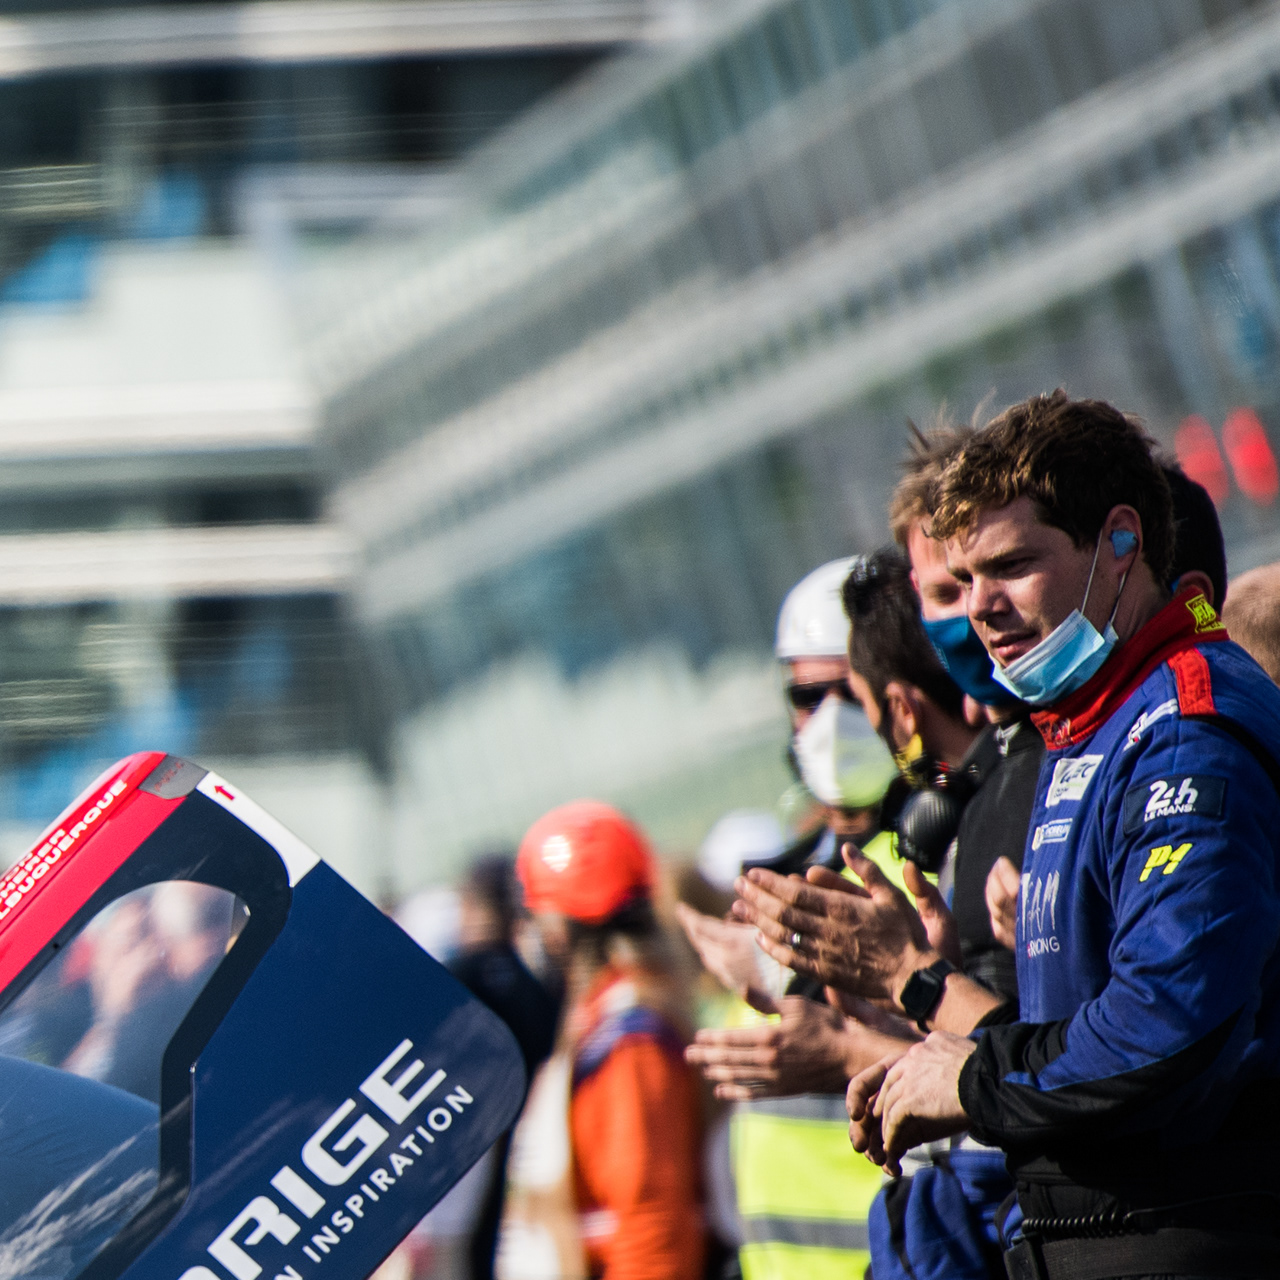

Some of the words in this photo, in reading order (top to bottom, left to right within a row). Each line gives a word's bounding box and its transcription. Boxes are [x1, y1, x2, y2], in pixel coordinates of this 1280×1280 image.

[1144, 810, 1156, 822] LE
[1139, 843, 1193, 882] P1
[302, 1085, 474, 1263] INSPIRATION
